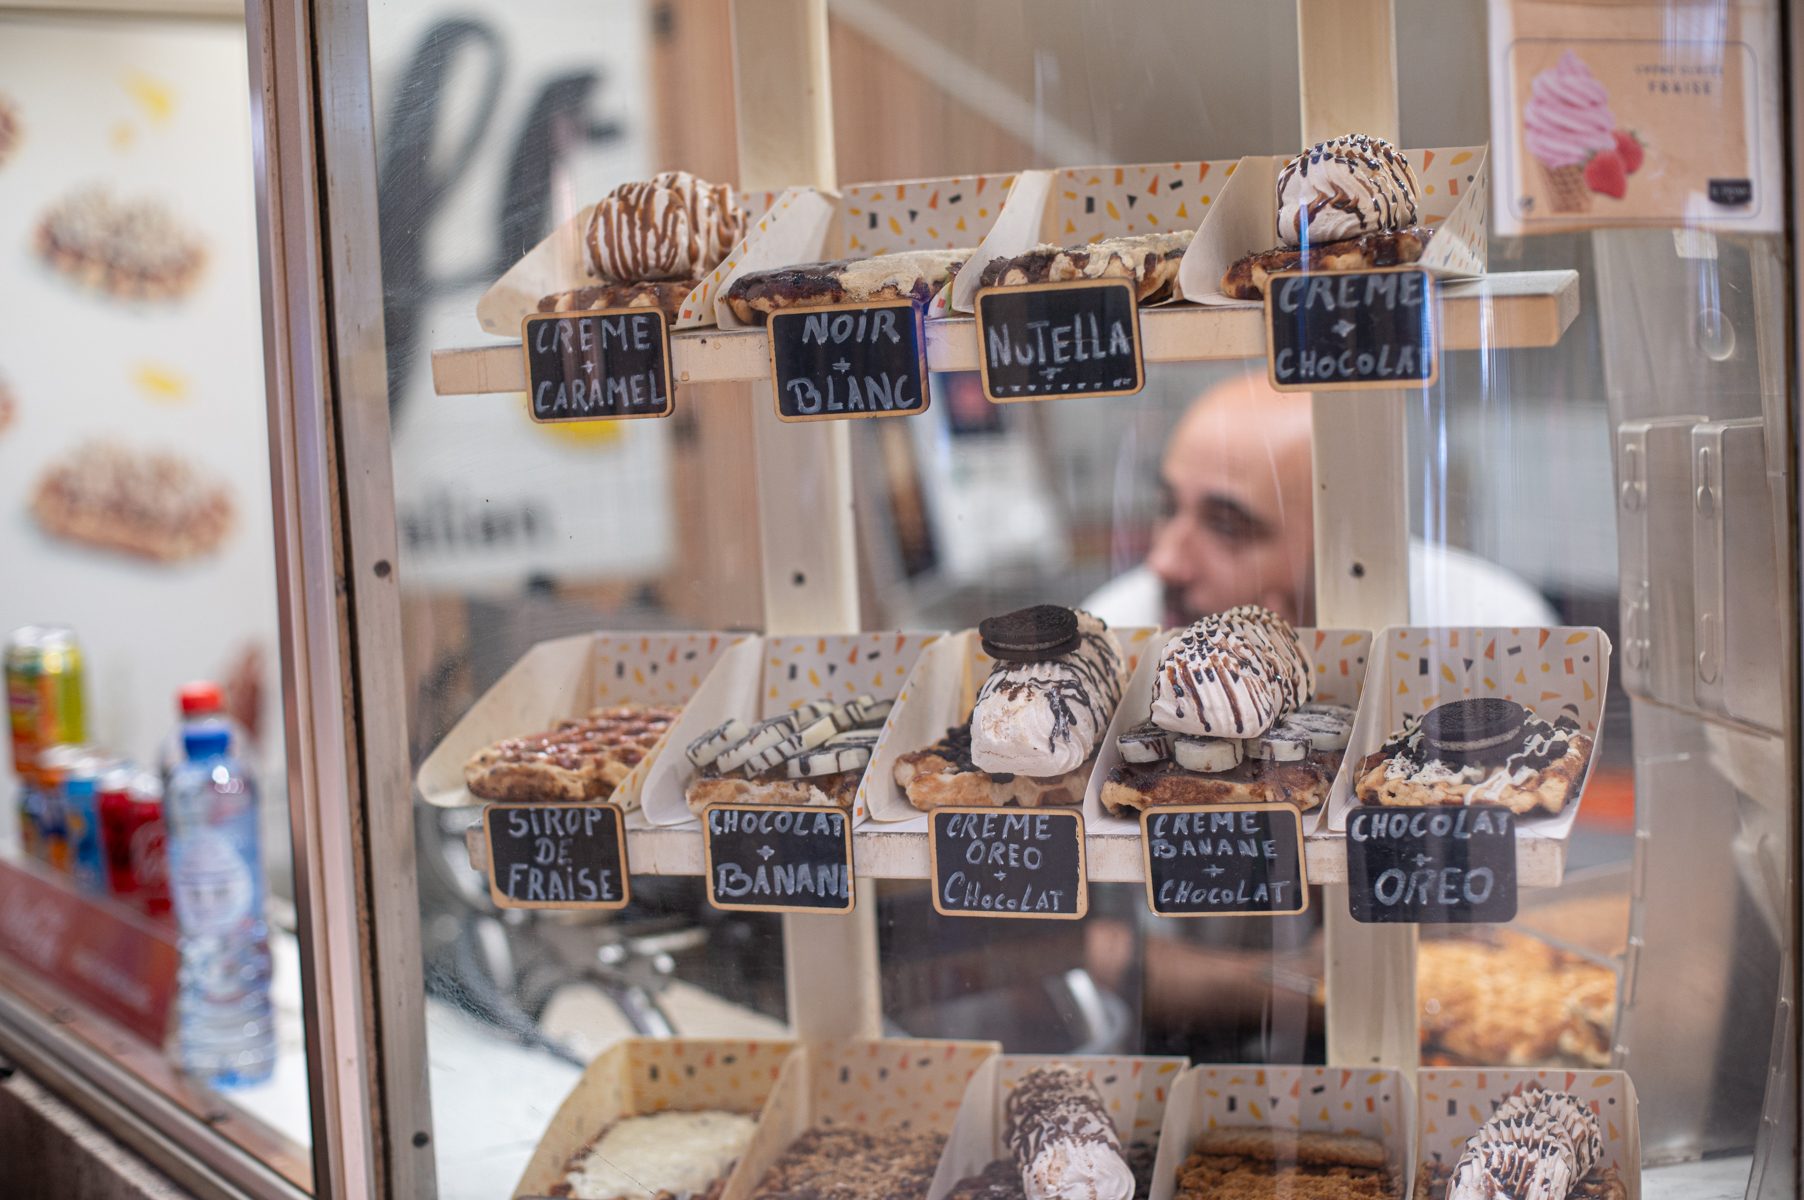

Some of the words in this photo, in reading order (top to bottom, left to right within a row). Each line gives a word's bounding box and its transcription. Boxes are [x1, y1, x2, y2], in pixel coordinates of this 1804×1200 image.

[1278, 272, 1424, 312] CREME
[535, 314, 652, 354] CREME
[535, 369, 667, 413] CARAMEL
[786, 371, 916, 414] BLANC
[709, 810, 844, 838] CHOCOLAT
[946, 813, 1053, 841] CREME
[1152, 811, 1262, 838] CREME
[1351, 809, 1511, 842] CHOCOLAT
[533, 836, 573, 867] DE
[965, 839, 1043, 871] OREO
[1150, 838, 1280, 859] BANANE
[1374, 866, 1495, 906] OREO
